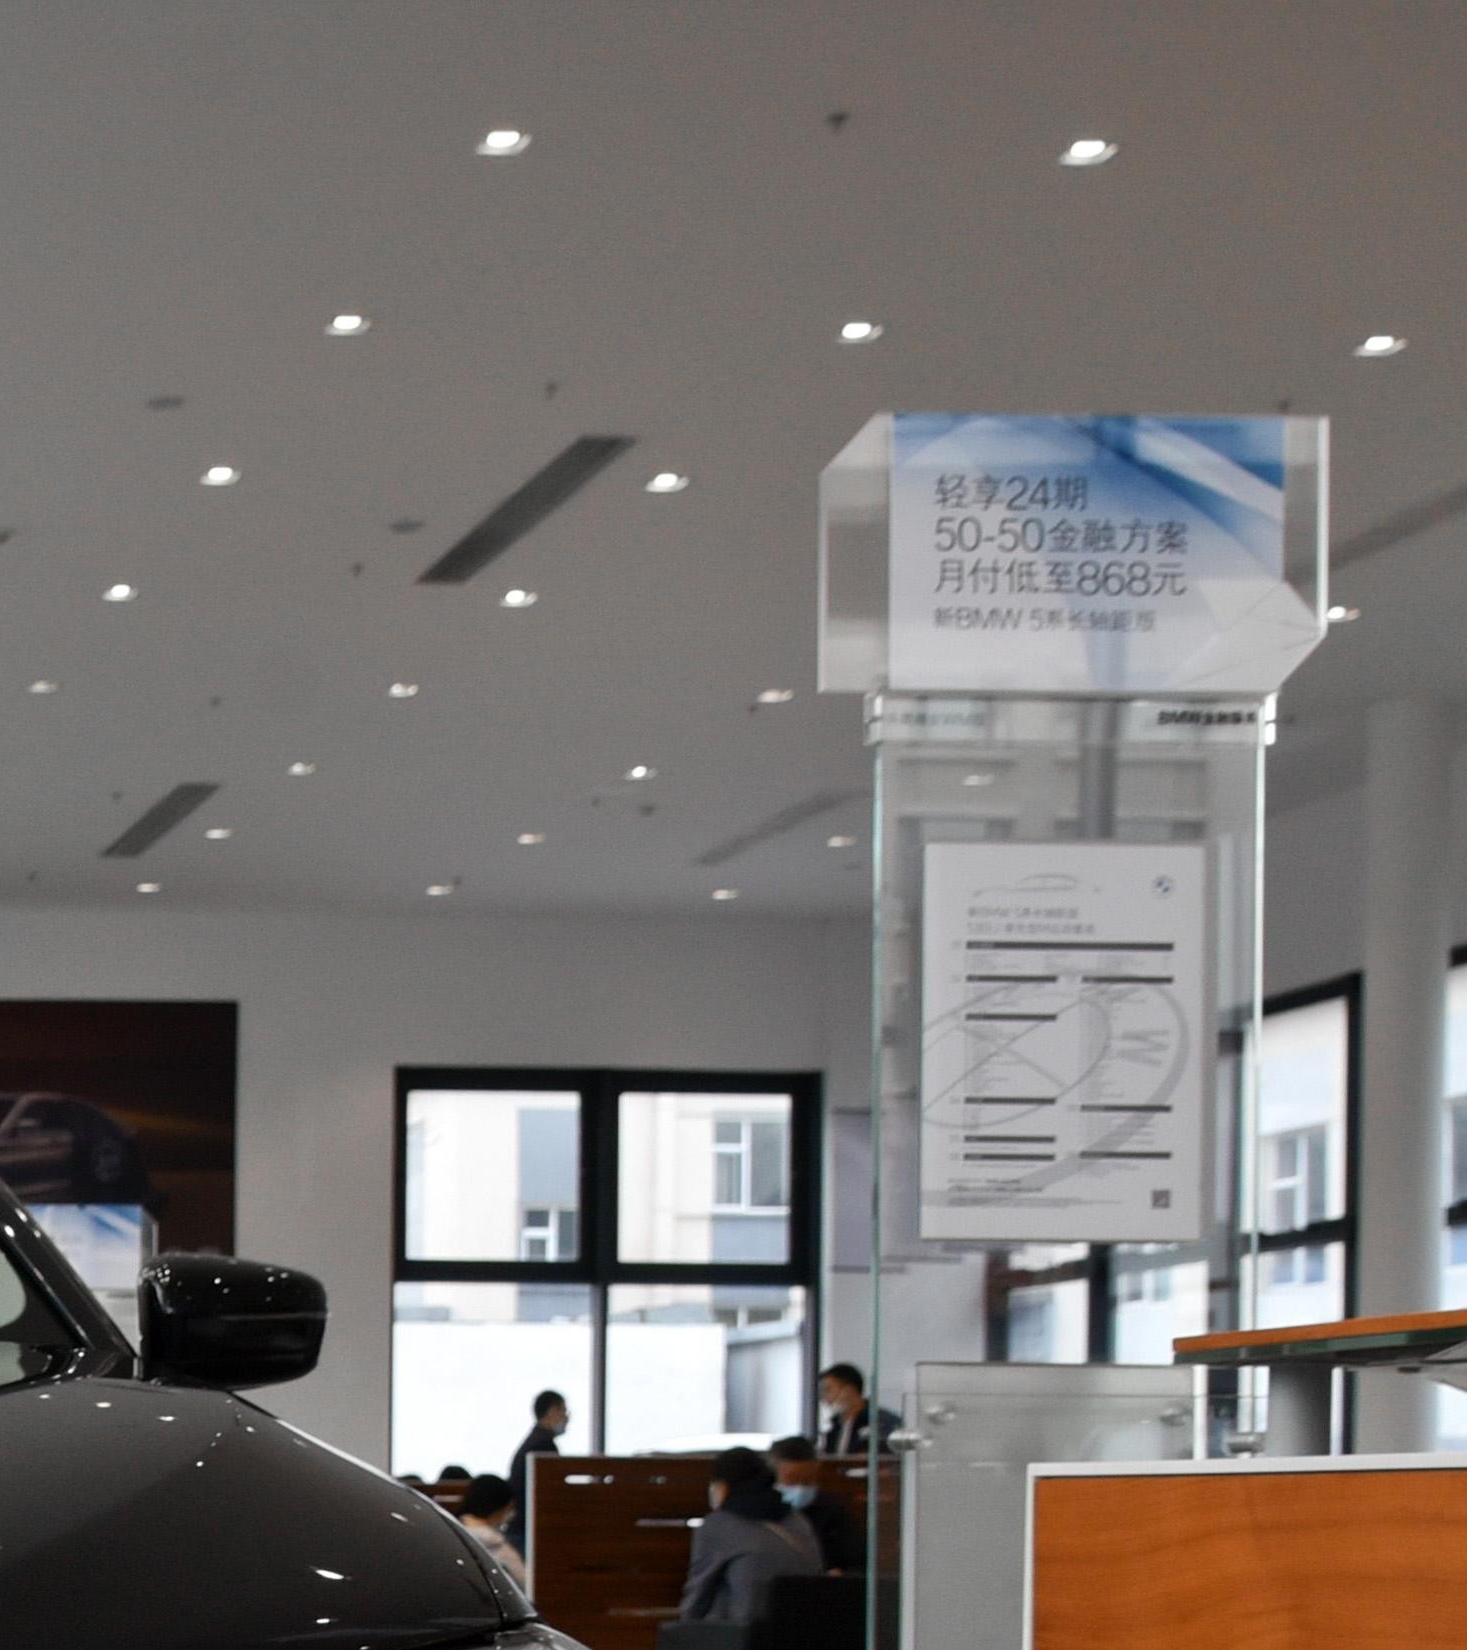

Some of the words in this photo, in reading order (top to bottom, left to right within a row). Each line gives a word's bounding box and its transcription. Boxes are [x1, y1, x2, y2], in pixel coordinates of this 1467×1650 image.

[934, 474, 1088, 511] 轻享24期
[934, 515, 1188, 554] 50-50金融方案
[934, 557, 1188, 597] 月付低至868元
